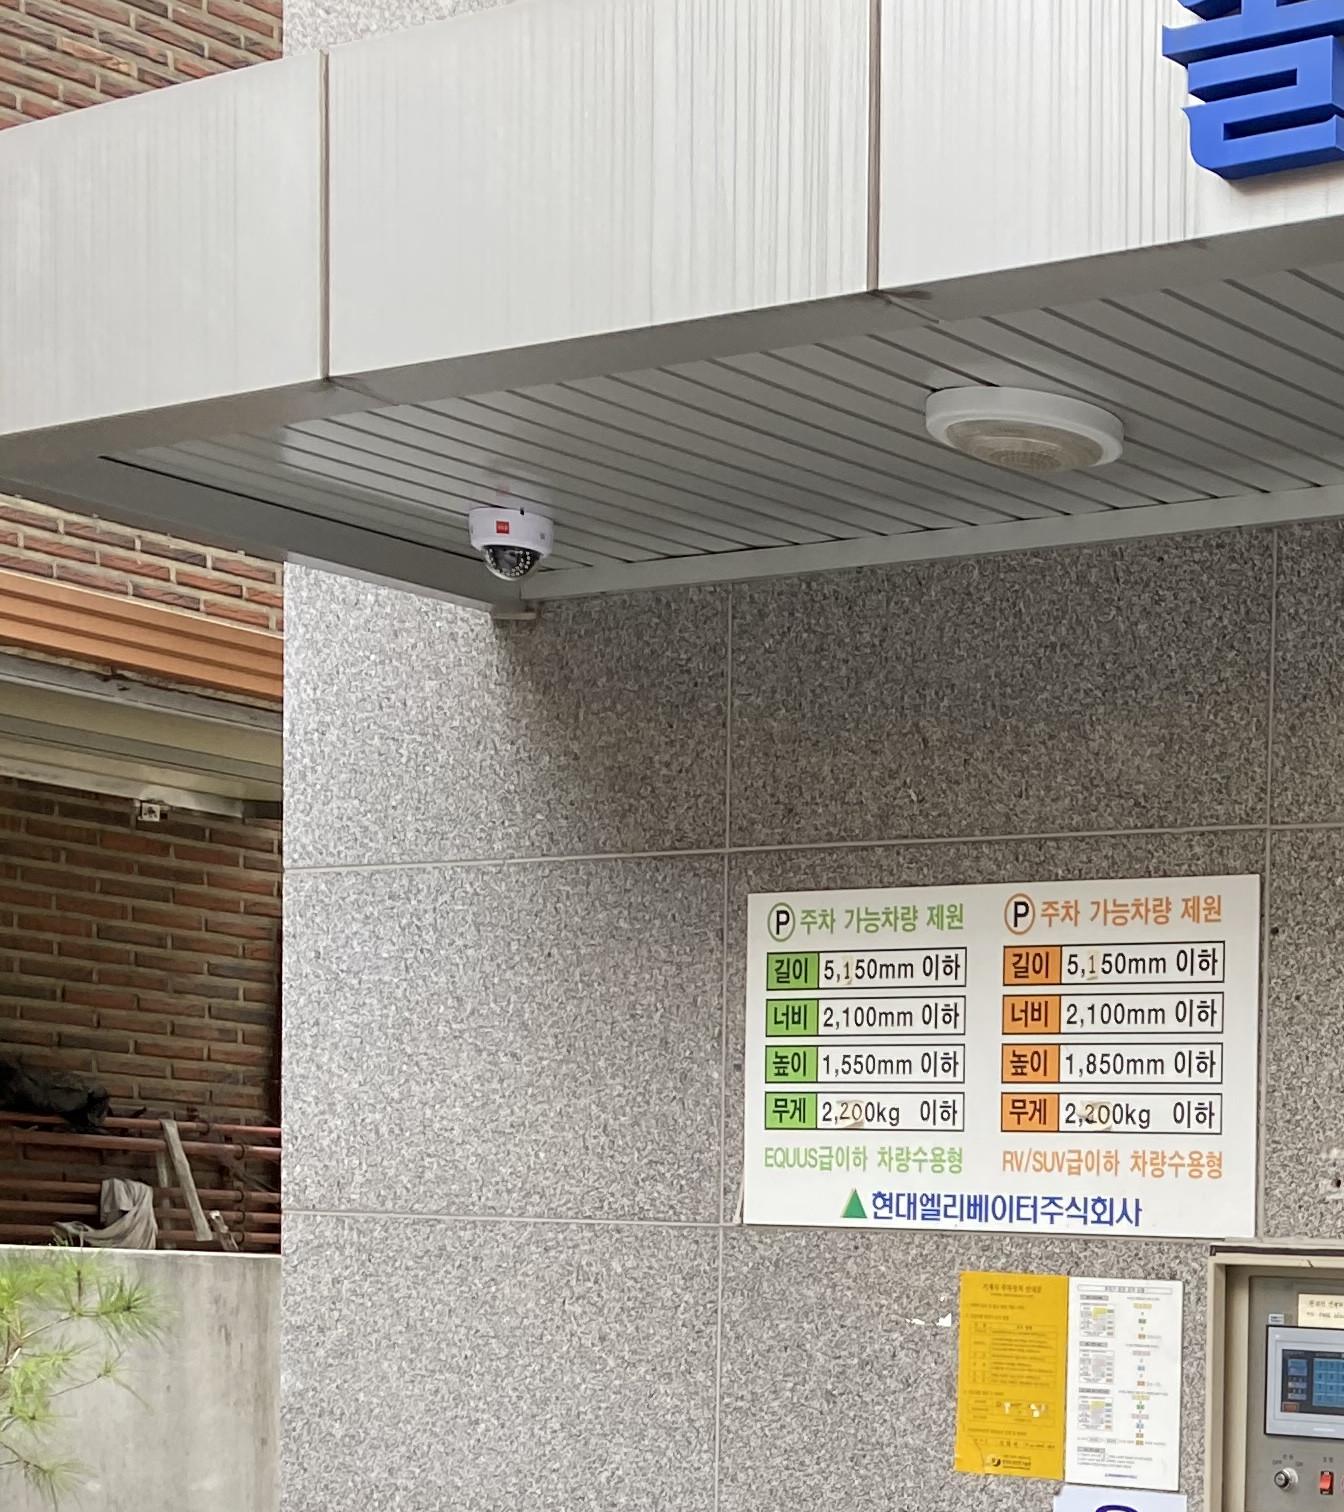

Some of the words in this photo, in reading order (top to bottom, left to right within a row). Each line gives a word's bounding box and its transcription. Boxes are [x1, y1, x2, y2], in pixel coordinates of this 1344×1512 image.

[800, 907, 836, 935] 주차
[844, 904, 919, 934] 가능차량
[926, 902, 964, 931] 제원
[1040, 899, 1081, 928] 주차
[1090, 896, 1172, 926] 가능차량
[1180, 894, 1223, 924] 제원
[773, 956, 809, 984] 길이
[824, 958, 914, 983] 5,150mm
[922, 953, 961, 981] 이하
[1012, 951, 1050, 979] 길이
[1067, 952, 1166, 977] 5,150mm
[1176, 947, 1218, 976] 이하
[773, 1004, 808, 1031] 너비
[823, 1006, 913, 1030] 2,100mm
[921, 1002, 960, 1029] 이하
[1011, 1000, 1049, 1028] 너비
[1066, 1002, 1166, 1028] 2,100mm
[1175, 998, 1217, 1027] 이하
[772, 1051, 807, 1077] 높이
[822, 1054, 913, 1077] 1,550mm
[920, 1050, 959, 1078] 이하
[1010, 1049, 1048, 1077] 높이
[1065, 1052, 1165, 1078] 1,850mm
[1174, 1050, 1216, 1078] 이하
[772, 1097, 806, 1124] 무게
[821, 1101, 900, 1126] 2,200kg
[920, 1099, 958, 1126] 이하
[1009, 1098, 1047, 1125] 무게
[1172, 1101, 1215, 1129] 이하
[764, 1146, 868, 1171] EQUUS급이하
[877, 1146, 963, 1174] 차량수용형
[1002, 1148, 1120, 1176] RV/SUV급이하
[1130, 1150, 1223, 1180] 차량수용형
[872, 1190, 1143, 1227] 현대엘리베이터주식회사
